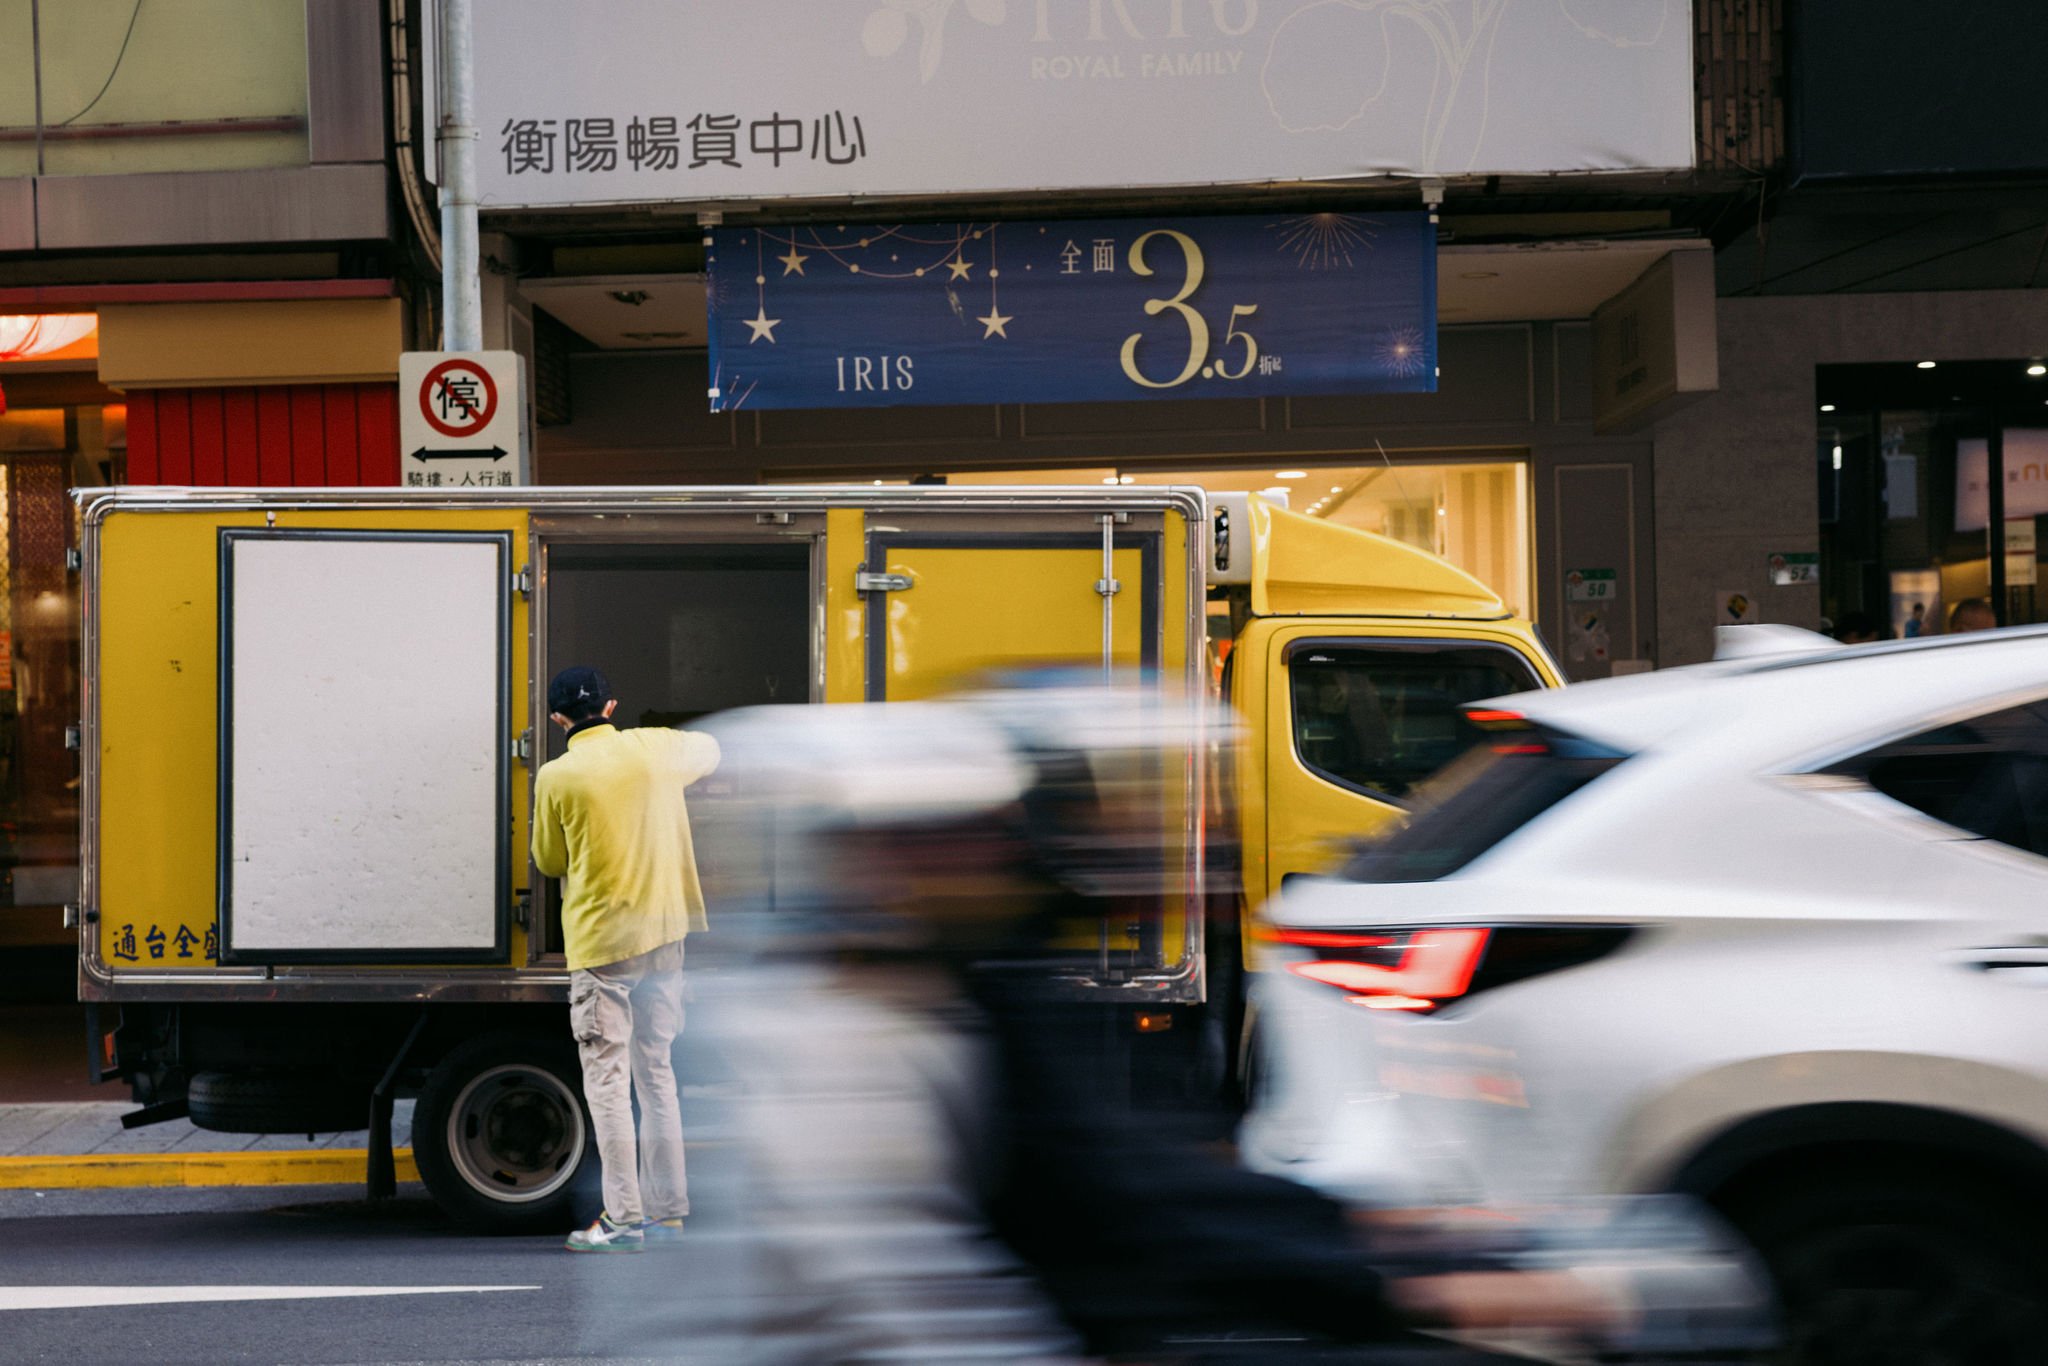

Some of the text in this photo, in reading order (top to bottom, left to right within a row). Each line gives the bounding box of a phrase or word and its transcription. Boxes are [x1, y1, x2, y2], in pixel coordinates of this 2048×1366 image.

[1031, 51, 1243, 80] ROYAL FAMILY
[501, 109, 867, 175] 衡陽暢貨中心
[1059, 238, 1116, 275] 全面
[1119, 229, 1259, 389] 3.5
[836, 355, 914, 392] IRIS
[436, 376, 480, 420] 停
[1587, 582, 1607, 598] 50
